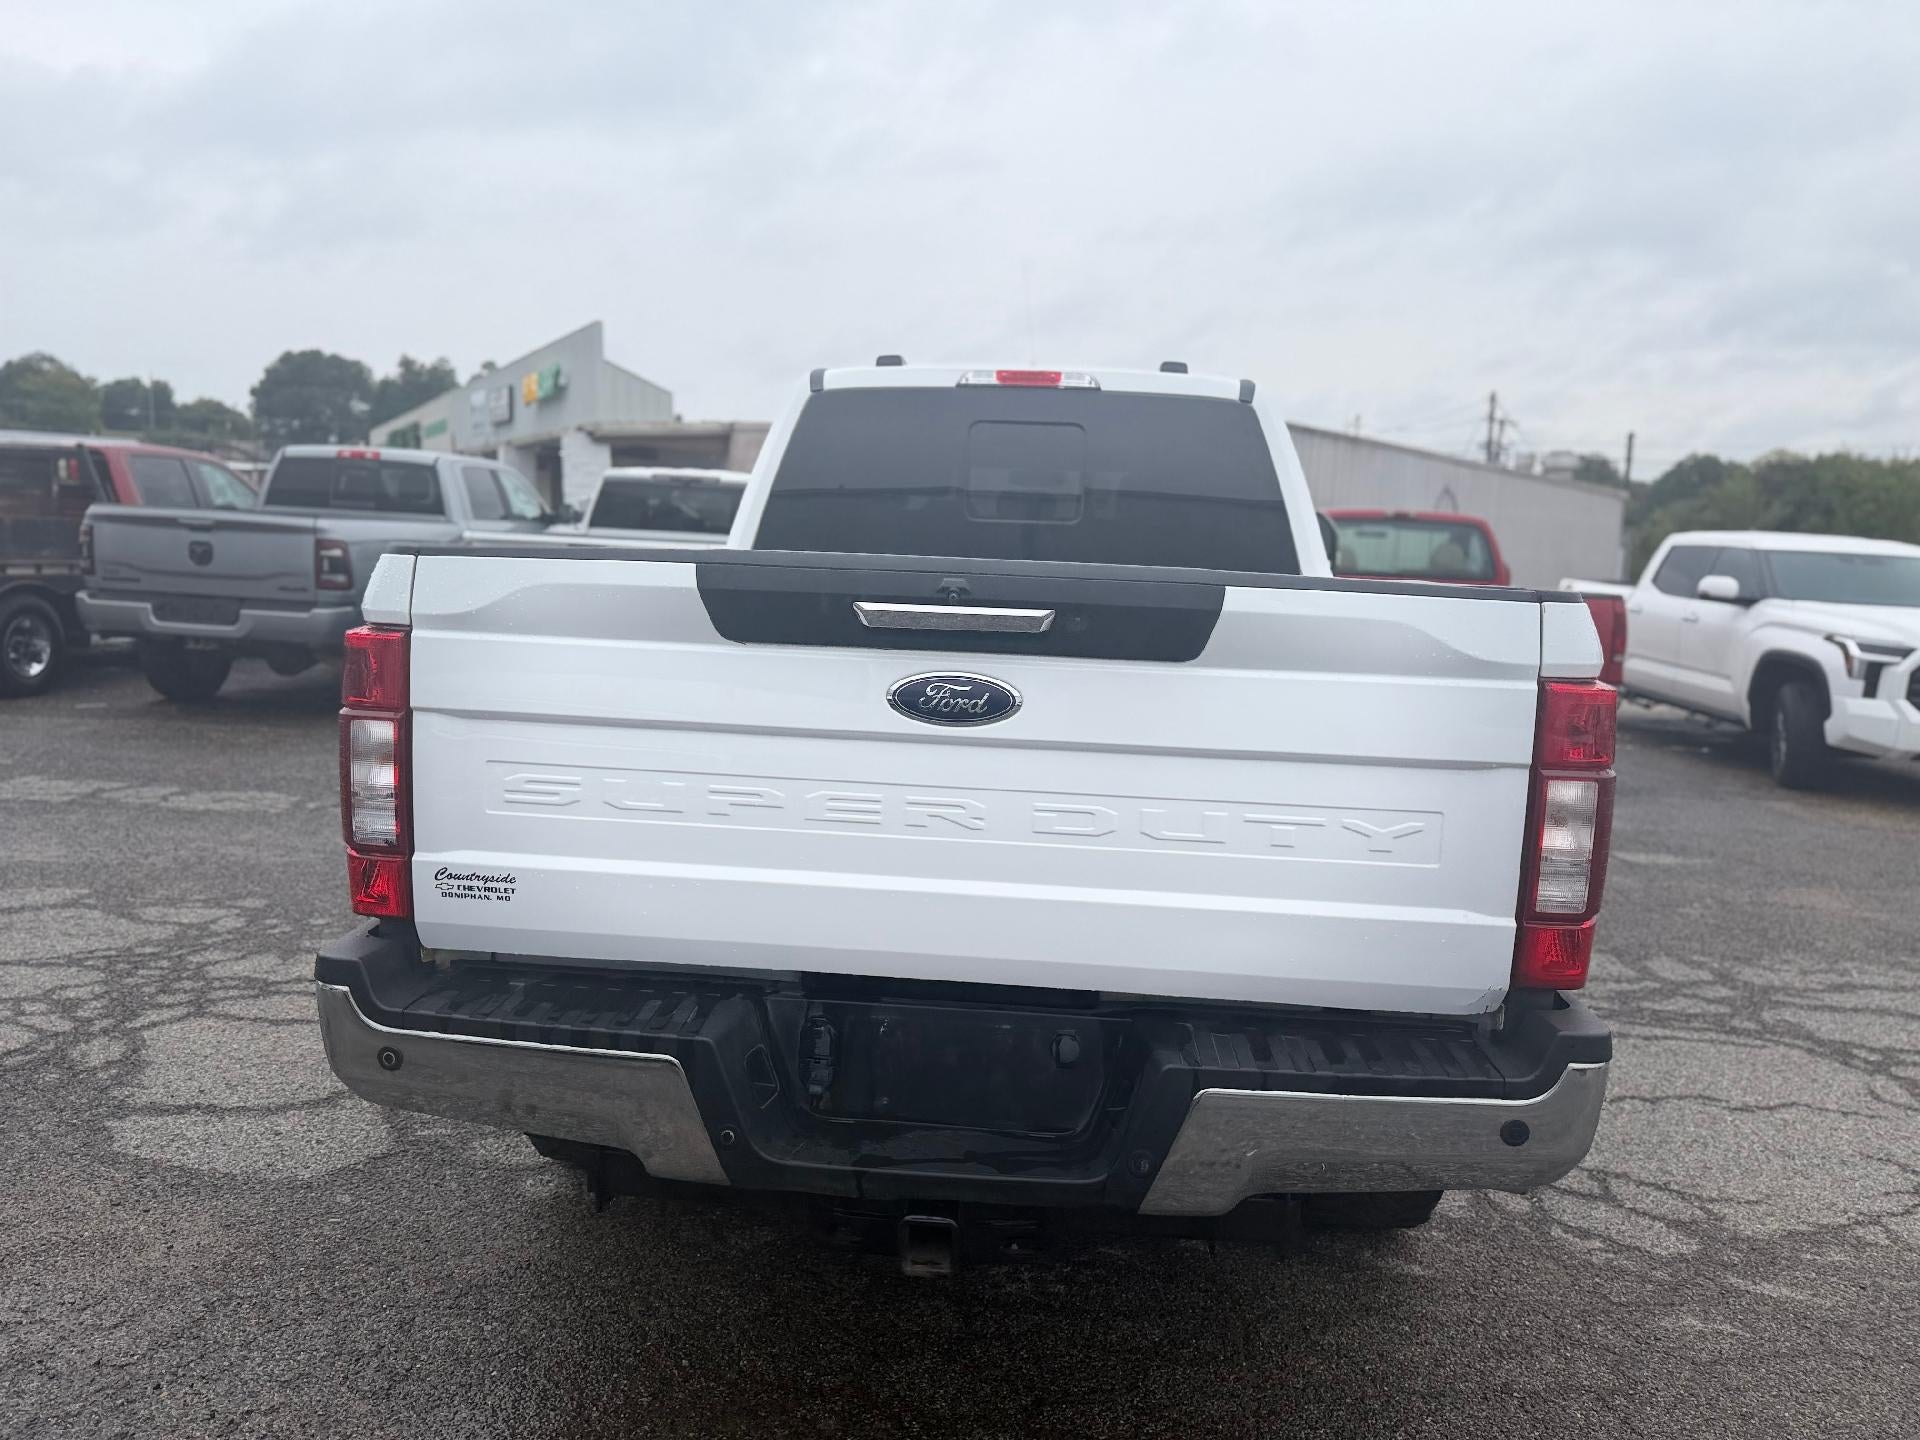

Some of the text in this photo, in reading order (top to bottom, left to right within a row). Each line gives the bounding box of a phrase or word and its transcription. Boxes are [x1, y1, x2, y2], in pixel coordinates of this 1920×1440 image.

[918, 682, 990, 713] Ford
[503, 773, 1425, 853] SUPER DUTY
[434, 867, 516, 885] Countryside
[457, 884, 516, 894] CHEVROLET
